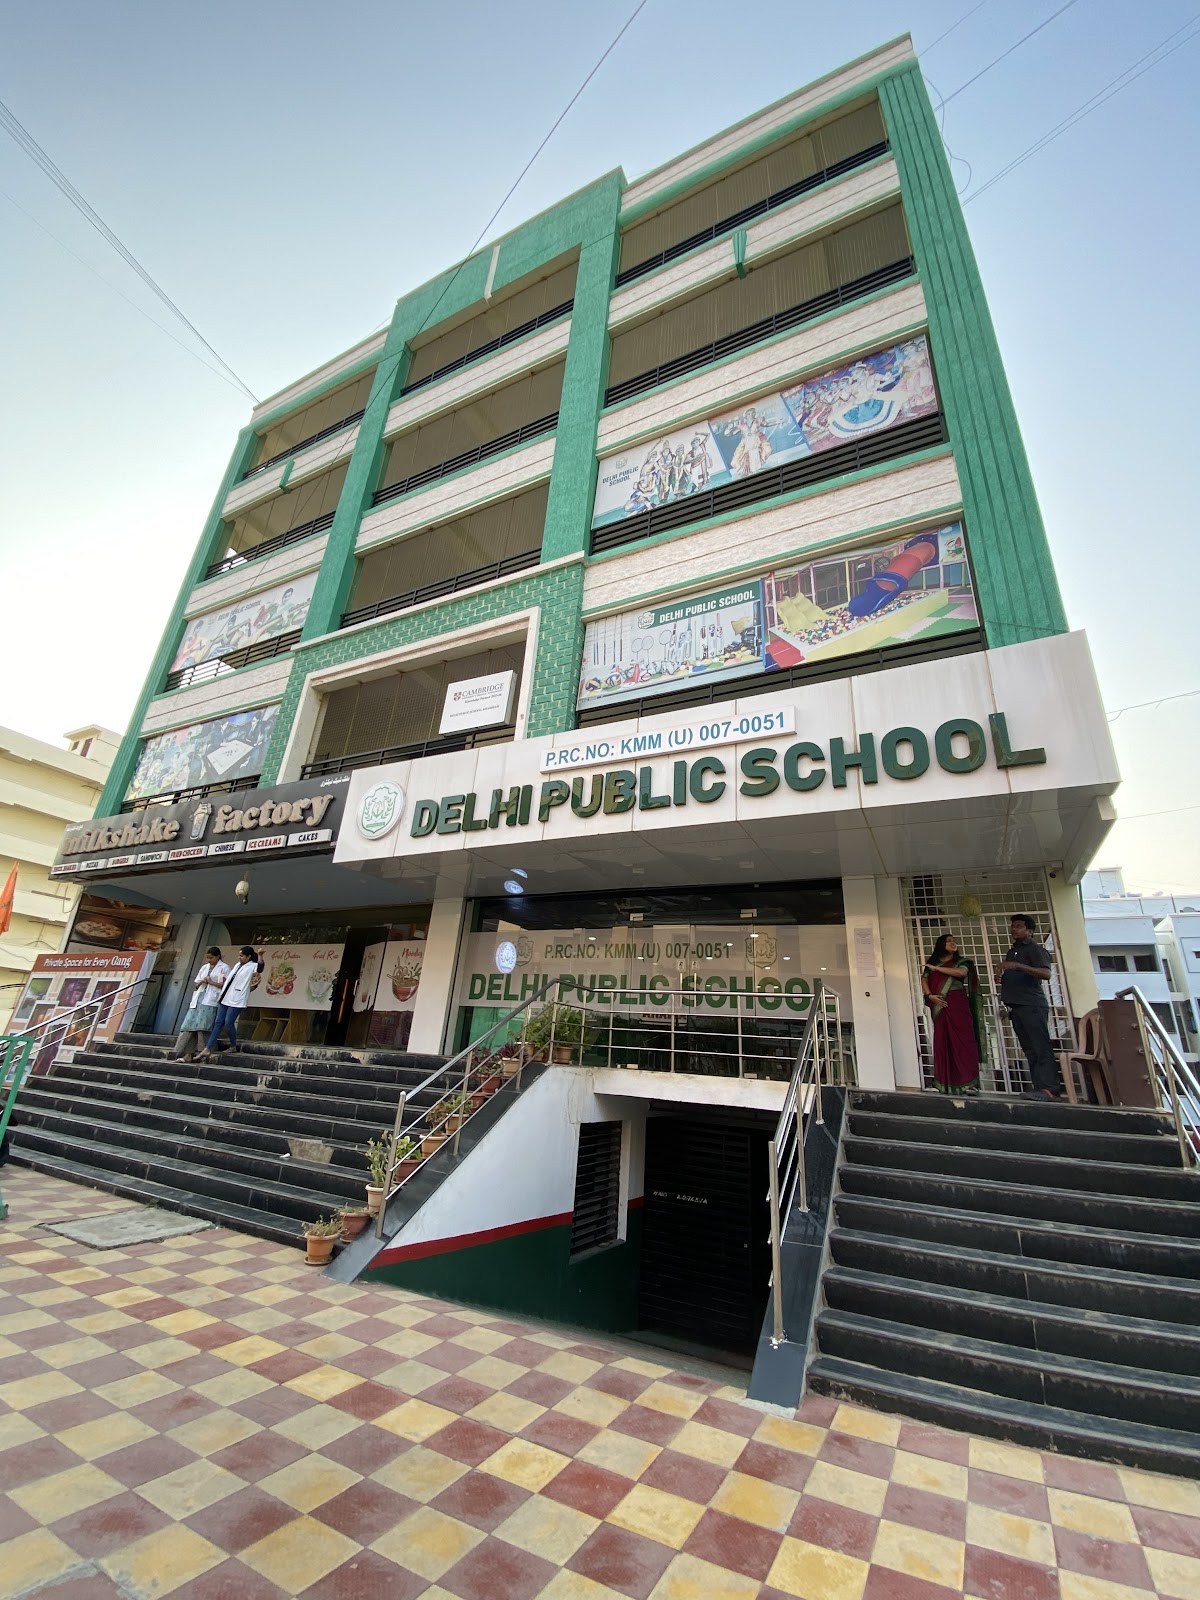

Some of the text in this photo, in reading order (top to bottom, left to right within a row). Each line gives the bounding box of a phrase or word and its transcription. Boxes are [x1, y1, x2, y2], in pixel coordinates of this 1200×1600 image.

[602, 466, 639, 484] DELHI PUBLIC
[609, 474, 630, 487] SCHOOL
[660, 590, 755, 623] DELHI PUBLIC SCHOOL
[462, 683, 504, 697] CAMBRIDGE
[545, 711, 784, 767] P.RC.NO: KMM (U) 007-0051
[410, 711, 1047, 839] DELHI PUBLIC SCHOOL
[62, 793, 334, 856] milkshake factory
[248, 838, 282, 849] ICE CREAMS
[298, 832, 319, 842] CAKES
[182, 847, 204, 856] CHICKEN
[214, 843, 236, 852] CHINESE
[140, 853, 163, 861] SANDWICH
[604, 943, 637, 958] KMM
[641, 942, 660, 962] (U)
[665, 942, 730, 959] 007-0051
[44, 955, 133, 969] Private Space for Every Gang
[468, 973, 549, 1002] DELHI
[557, 973, 670, 1006] PUBLIC
